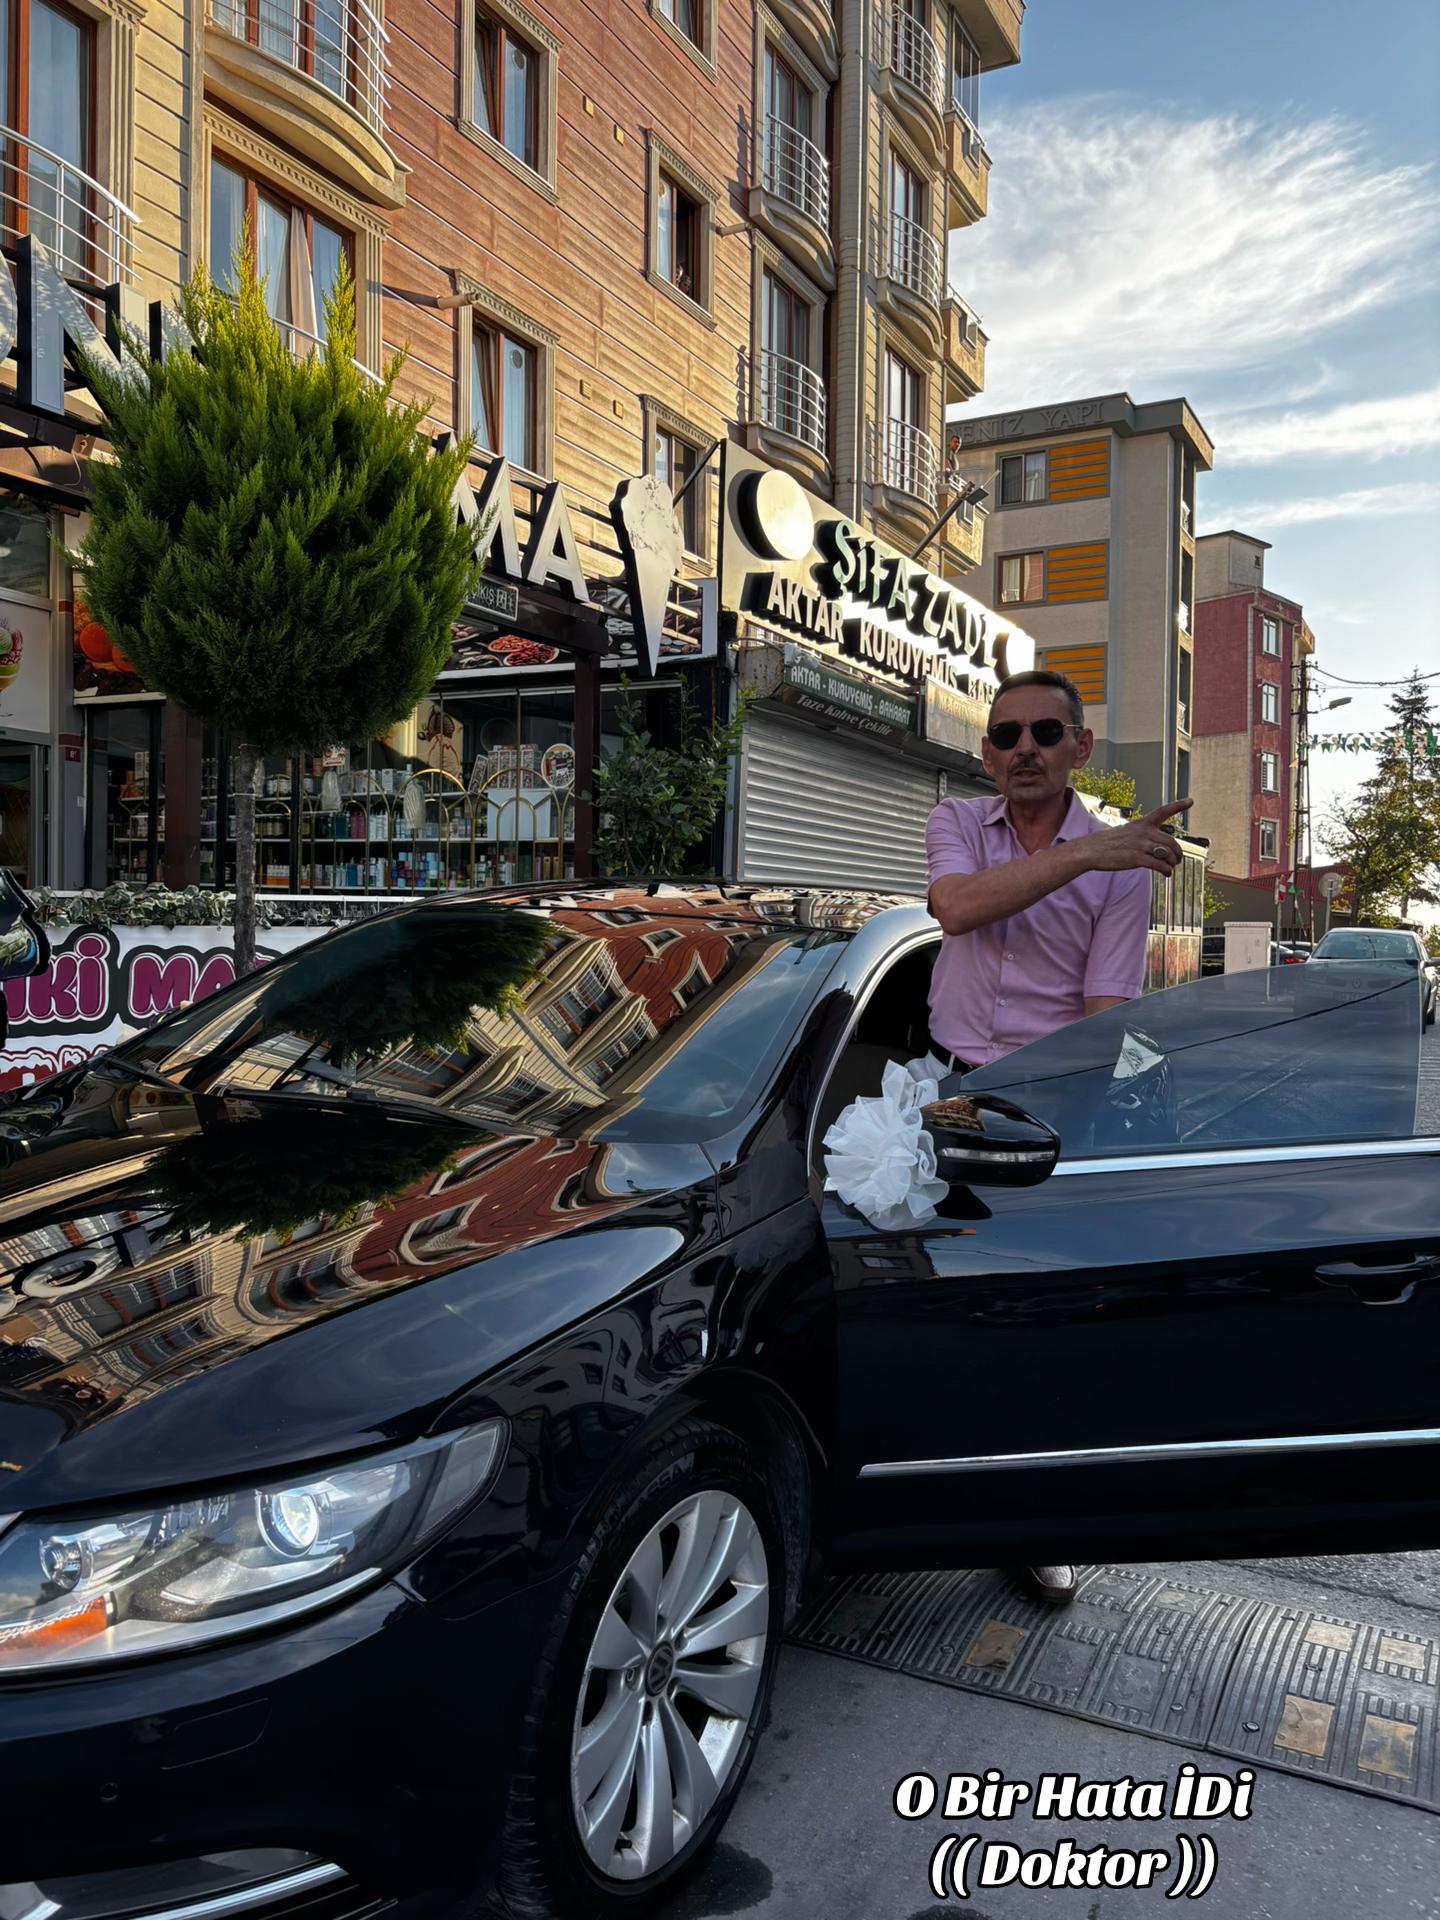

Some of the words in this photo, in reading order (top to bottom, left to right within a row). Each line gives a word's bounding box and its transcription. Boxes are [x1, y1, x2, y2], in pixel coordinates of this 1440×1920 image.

[1040, 402, 1104, 431] YAPI
[766, 571, 845, 645] AKTAR
[790, 665, 821, 690] AKTAR
[827, 678, 874, 716] KURUYEMİŞ
[796, 693, 826, 712] Taze
